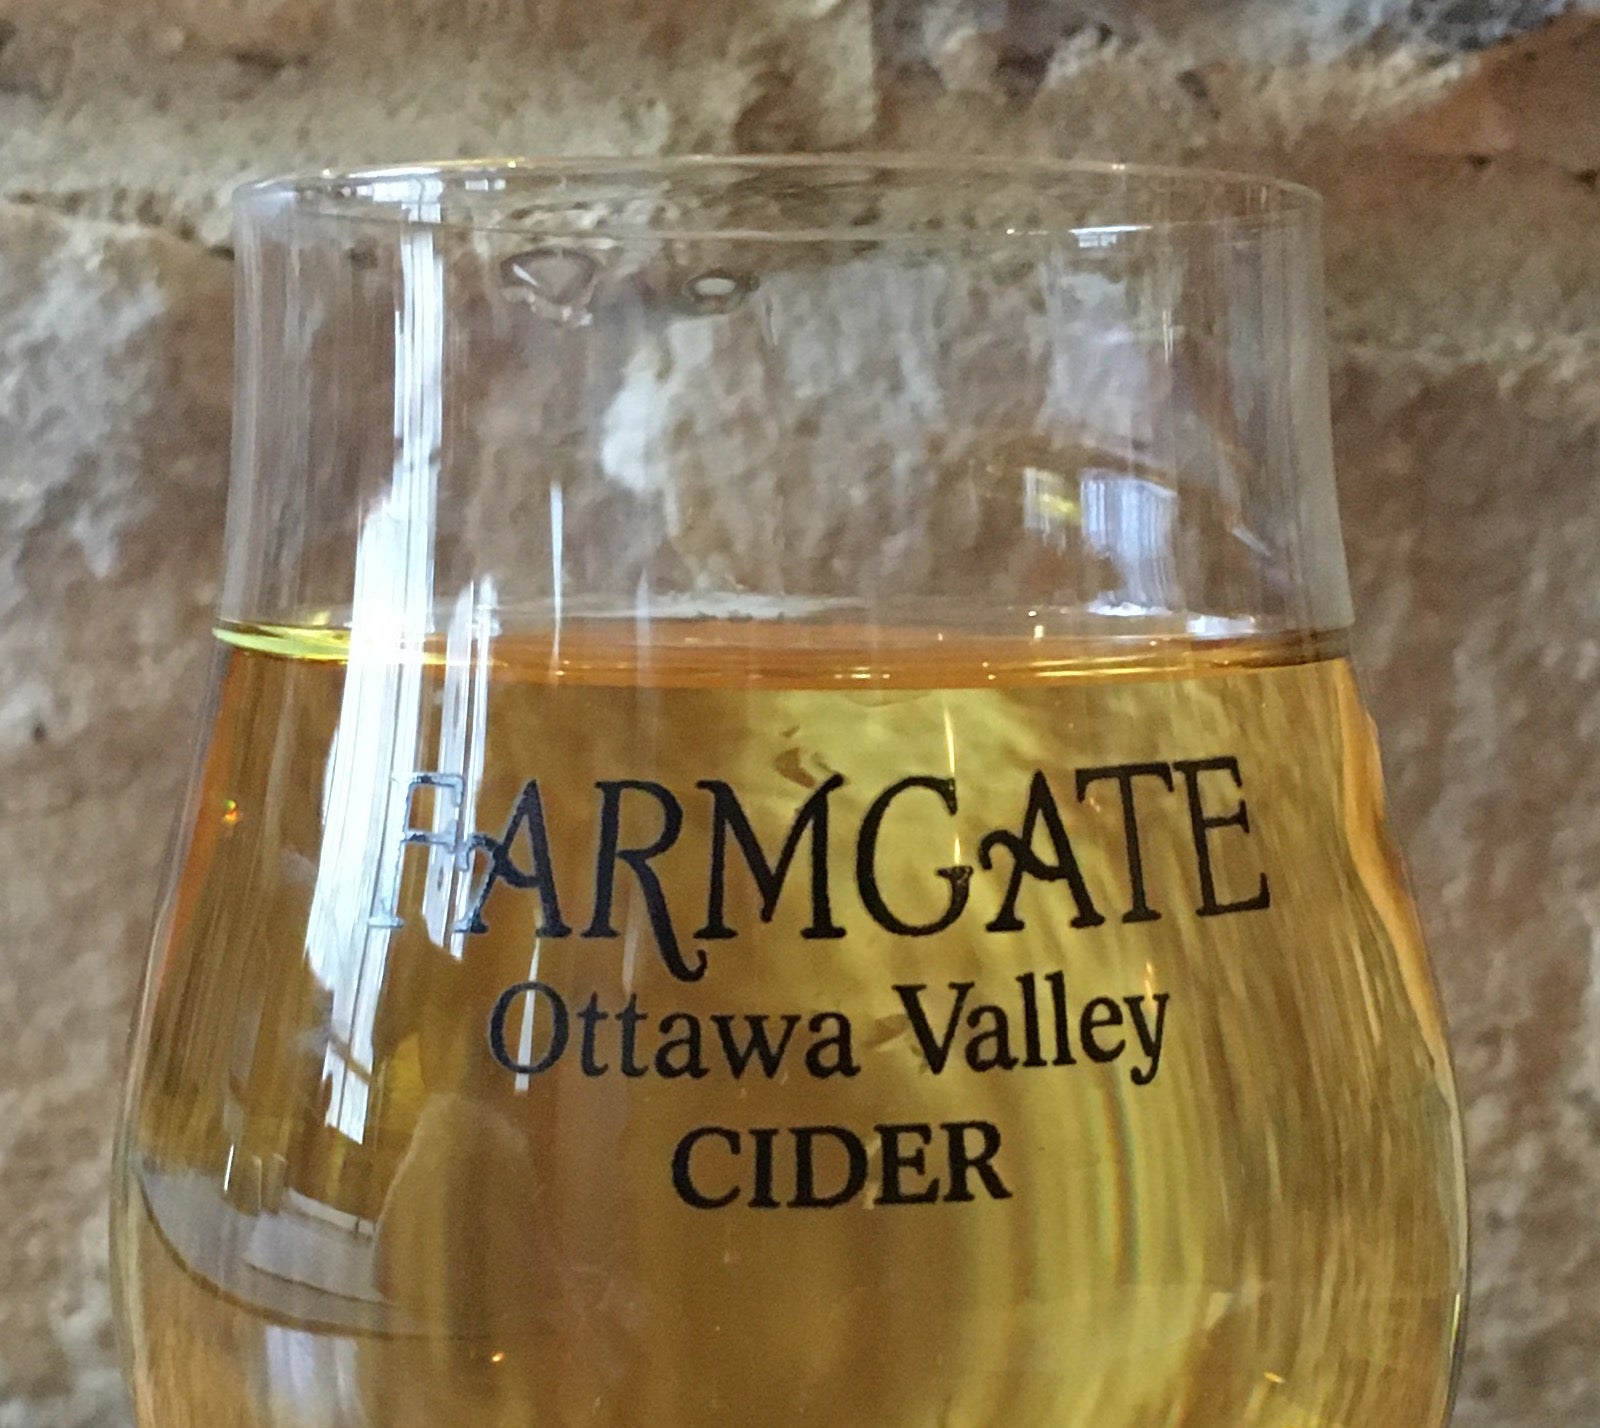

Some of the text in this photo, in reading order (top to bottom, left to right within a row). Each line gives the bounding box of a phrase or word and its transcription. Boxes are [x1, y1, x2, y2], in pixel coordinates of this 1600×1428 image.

[367, 756, 1271, 982] FARMGATE
[487, 971, 1170, 1085] Ottawa Valley
[671, 1120, 1013, 1209] CIDER
